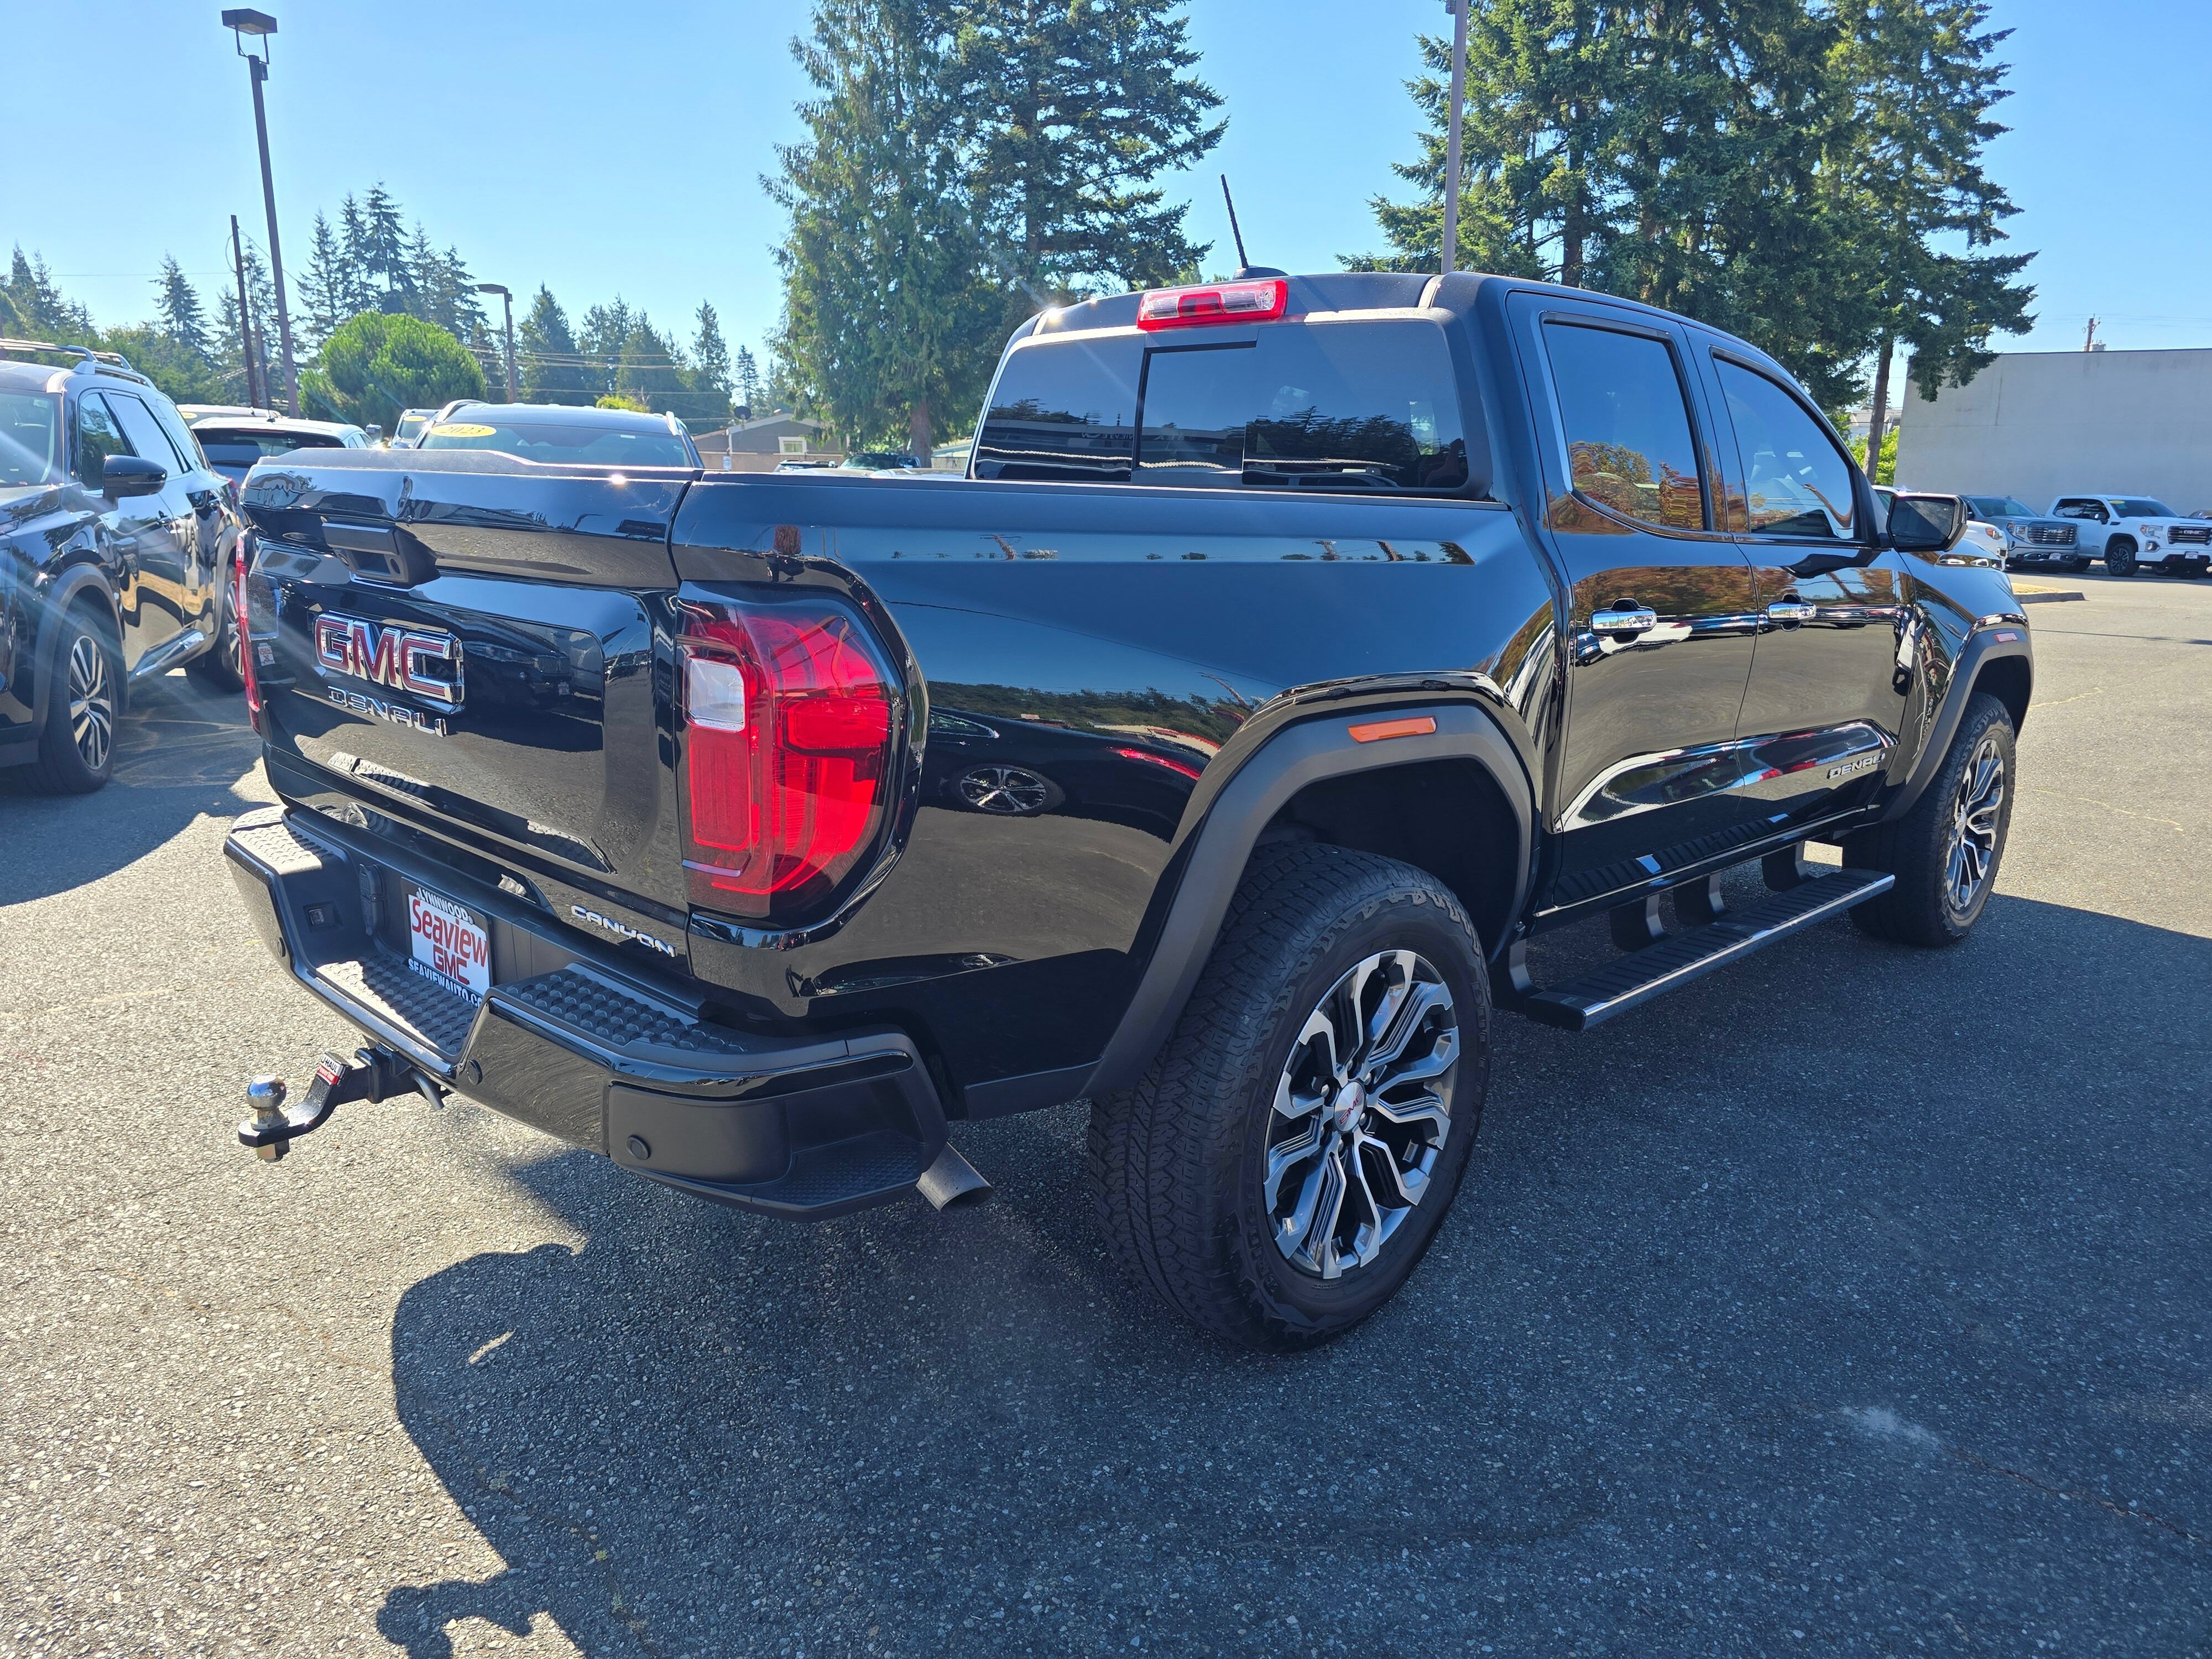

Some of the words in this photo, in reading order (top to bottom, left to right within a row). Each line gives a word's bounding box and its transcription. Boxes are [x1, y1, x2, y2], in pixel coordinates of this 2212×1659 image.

[315, 613, 463, 704] GMC
[328, 686, 447, 737] DENALI
[1827, 753, 1886, 779] DENALI
[418, 887, 469, 922] LYNNWOOD
[412, 899, 489, 968] Seaview
[571, 905, 677, 957] CANYON
[408, 958, 483, 1008] SEAVIEWAUTO.CO
[434, 945, 469, 985] GMC
[1339, 1088, 1364, 1125] GMC
